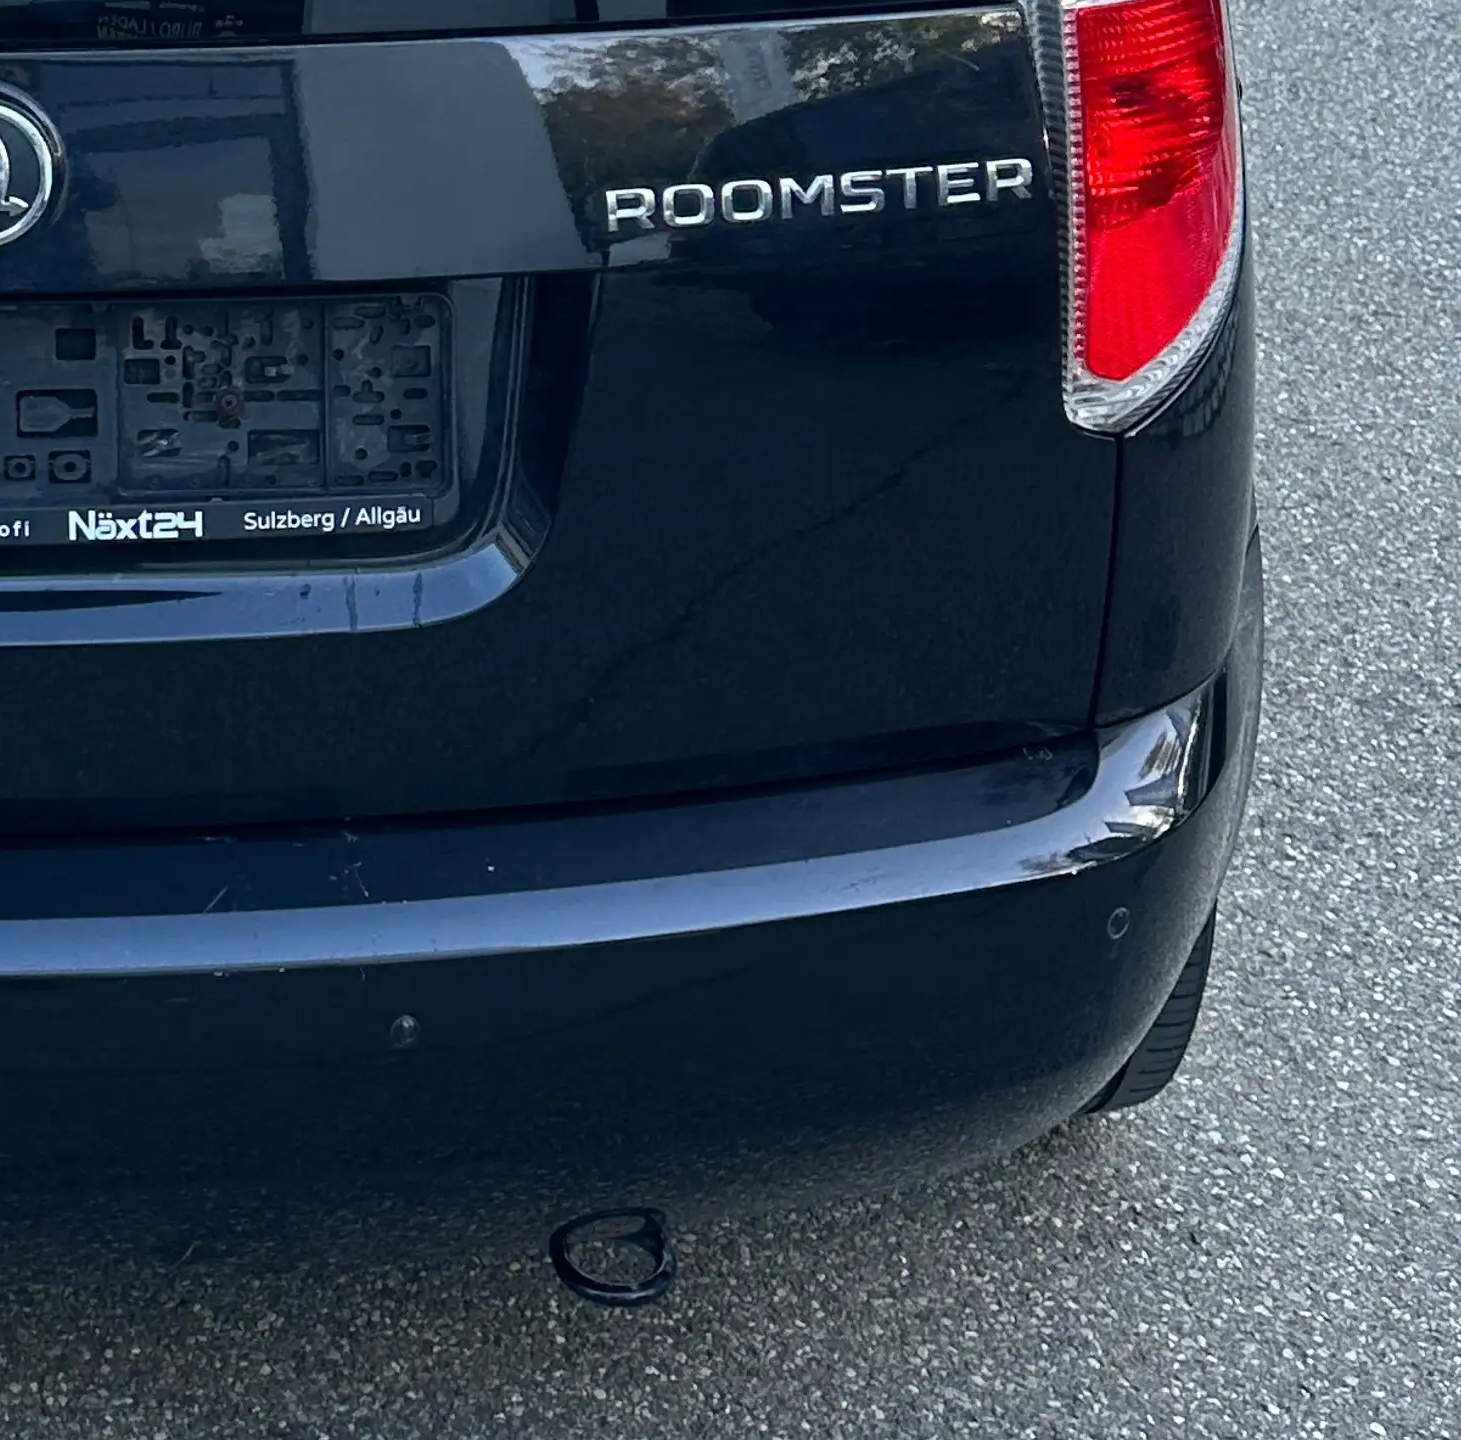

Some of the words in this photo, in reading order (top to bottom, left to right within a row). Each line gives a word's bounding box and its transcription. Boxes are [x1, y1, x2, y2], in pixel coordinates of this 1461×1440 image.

[605, 158, 1033, 233] ROOMSTER
[68, 509, 203, 541] Näxt24
[243, 510, 335, 532] Sulzberg
[355, 505, 421, 530] Allgäu
